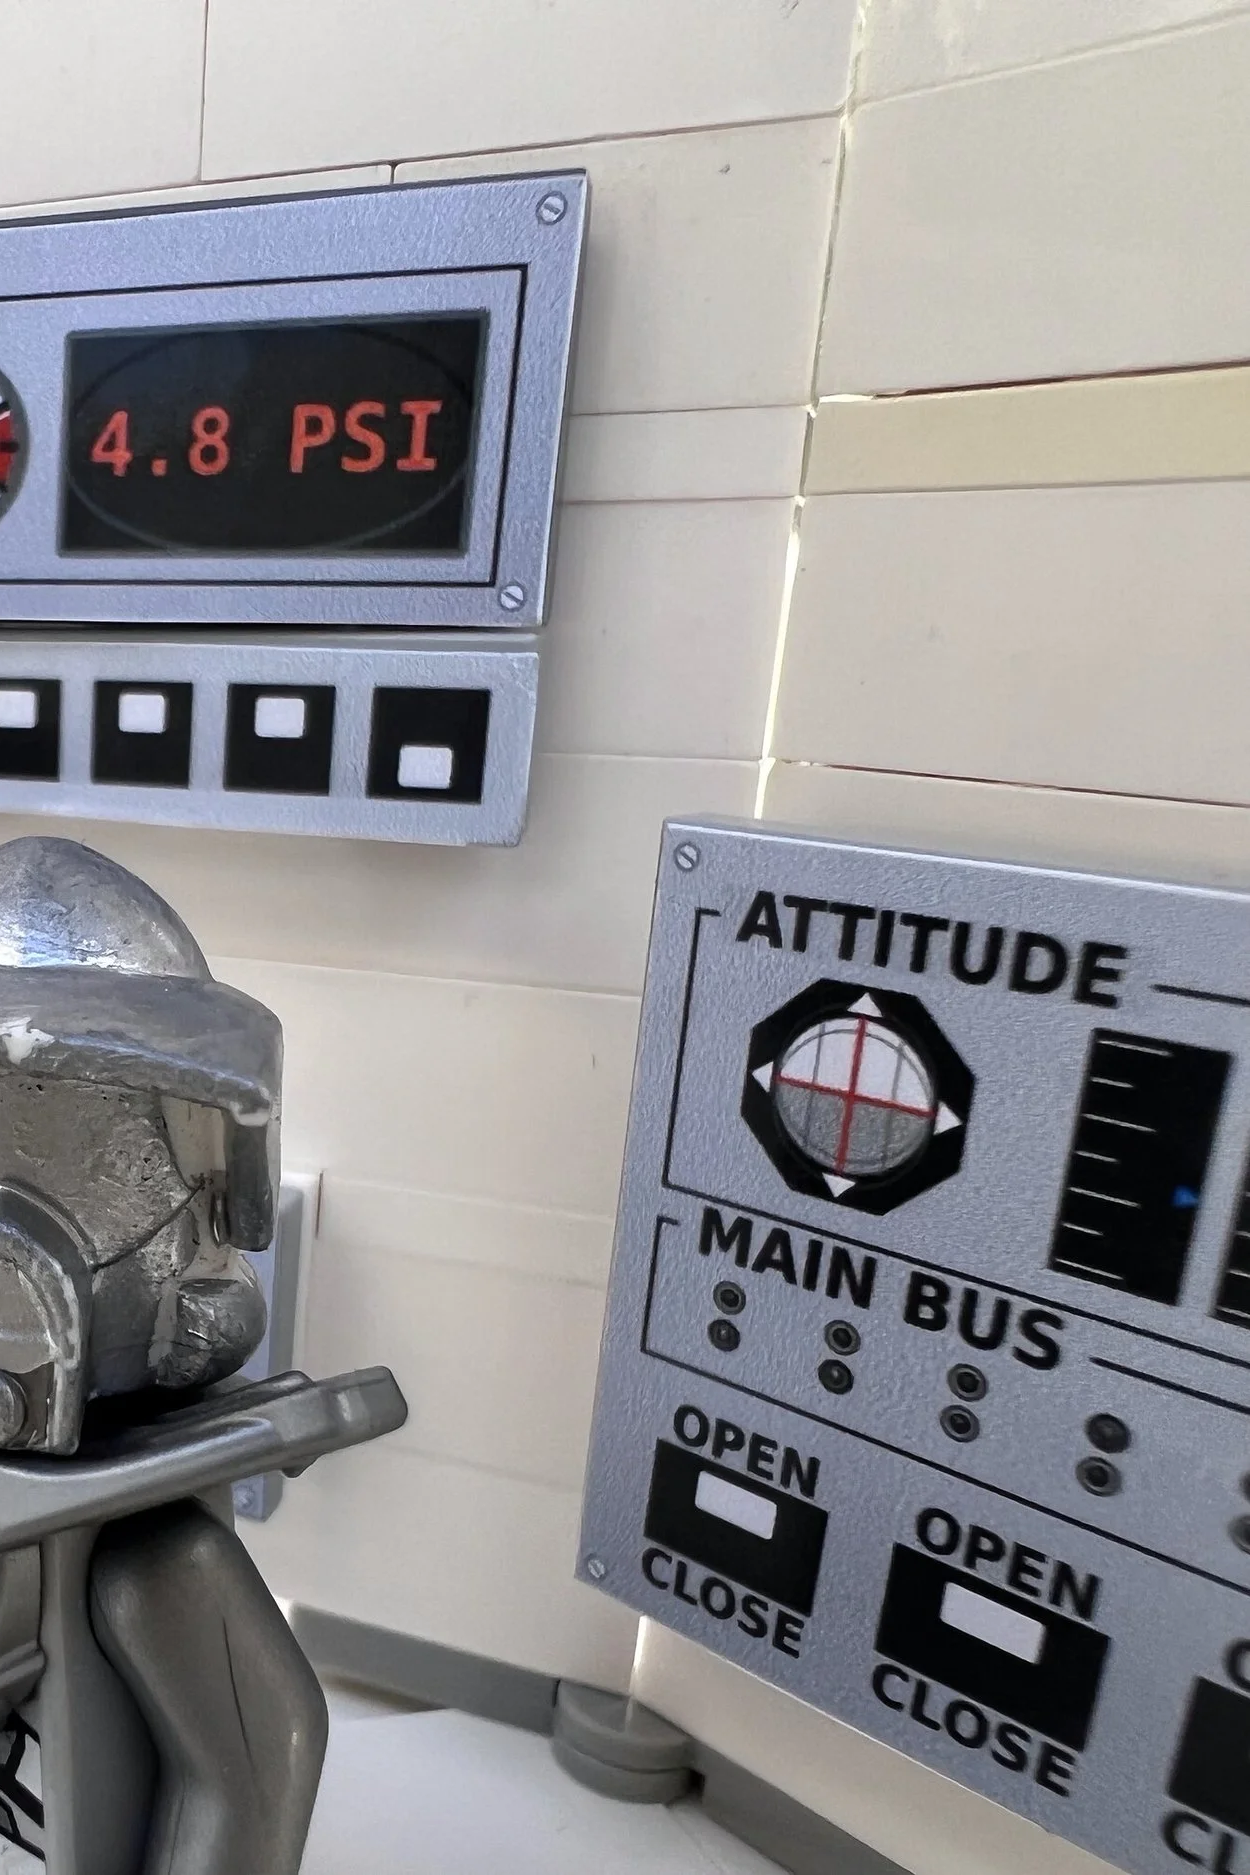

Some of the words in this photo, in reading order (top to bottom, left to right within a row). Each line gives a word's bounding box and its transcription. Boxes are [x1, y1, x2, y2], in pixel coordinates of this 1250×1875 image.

[89, 406, 231, 478] 4.8
[288, 399, 444, 476] PSI
[735, 890, 1128, 1008] ATTITUDE
[698, 1207, 877, 1309] MAIN
[902, 1271, 1064, 1371] BUS
[672, 1404, 821, 1499] OPEN
[642, 1546, 806, 1659] CLOSE
[915, 1507, 1101, 1621] OPEN
[871, 1663, 1077, 1798] CLOSE
